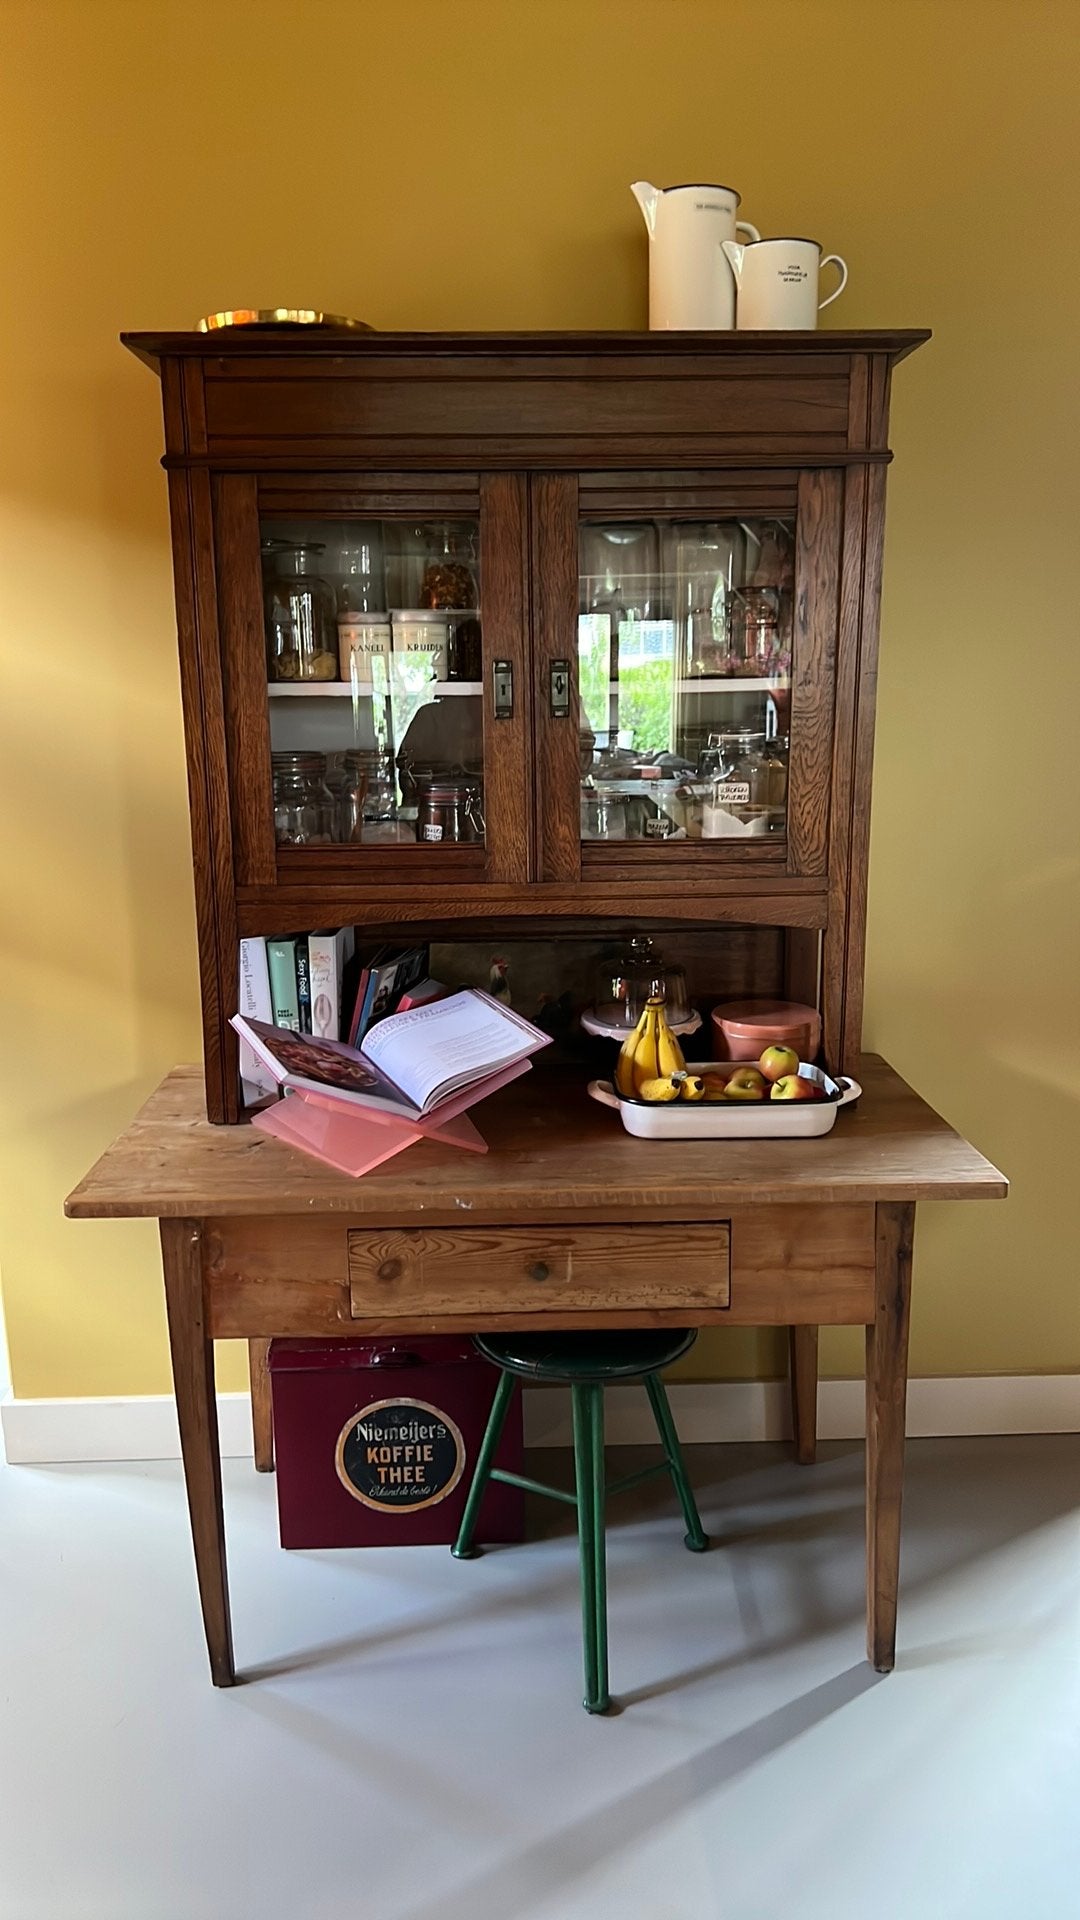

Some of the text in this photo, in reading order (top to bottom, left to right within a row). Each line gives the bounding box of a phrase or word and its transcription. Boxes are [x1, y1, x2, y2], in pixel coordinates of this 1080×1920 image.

[241, 940, 257, 1011] Giorgio Locatelli
[297, 958, 308, 995] Sexy Food
[356, 1421, 446, 1443] Niemeijers
[367, 1445, 434, 1464] KOFFIE
[377, 1466, 425, 1484] THEE
